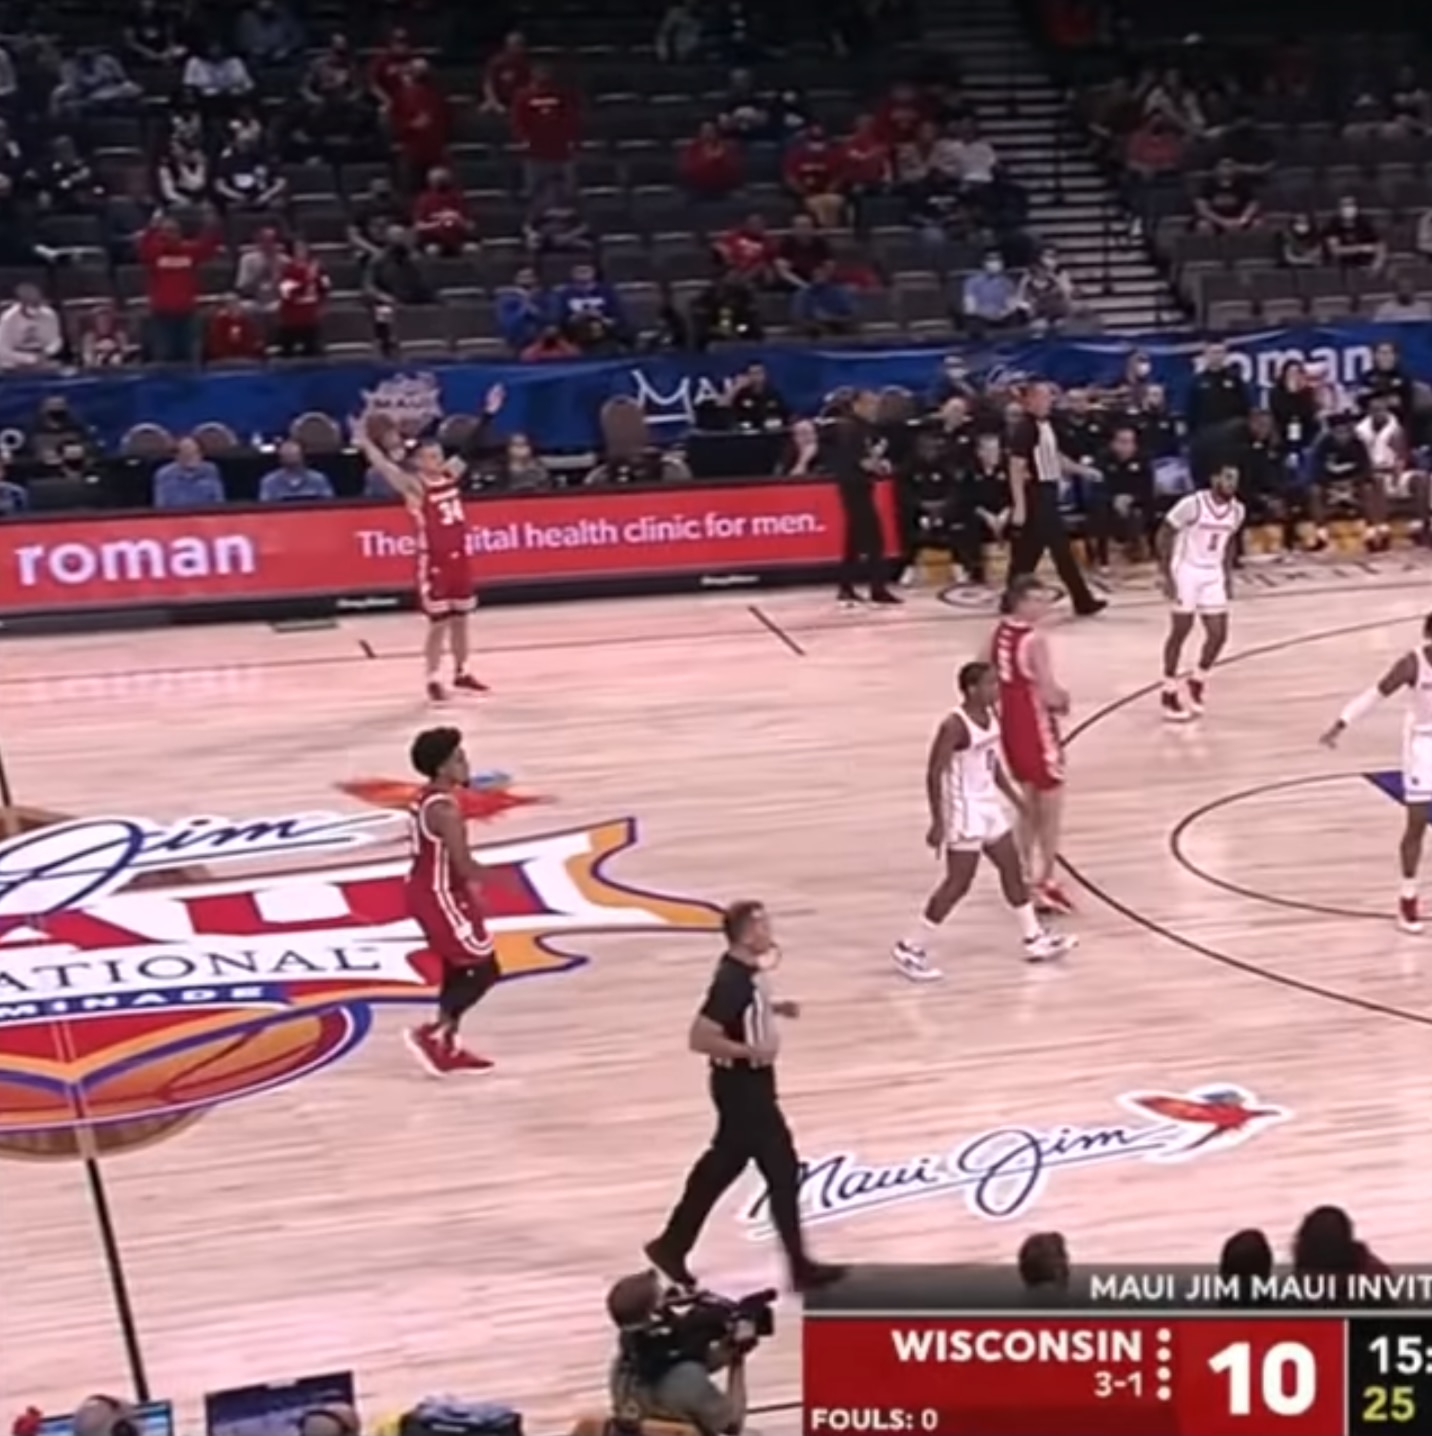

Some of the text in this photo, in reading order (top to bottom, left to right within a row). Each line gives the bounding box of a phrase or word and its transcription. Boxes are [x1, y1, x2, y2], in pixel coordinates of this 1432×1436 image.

[356, 530, 416, 557] The
[524, 519, 619, 548] health
[623, 514, 702, 543] clinic
[705, 511, 747, 538] for
[751, 513, 827, 536] men.
[438, 499, 465, 525] 34
[14, 534, 255, 586] roman
[749, 1128, 1176, 1218] Maui Jim
